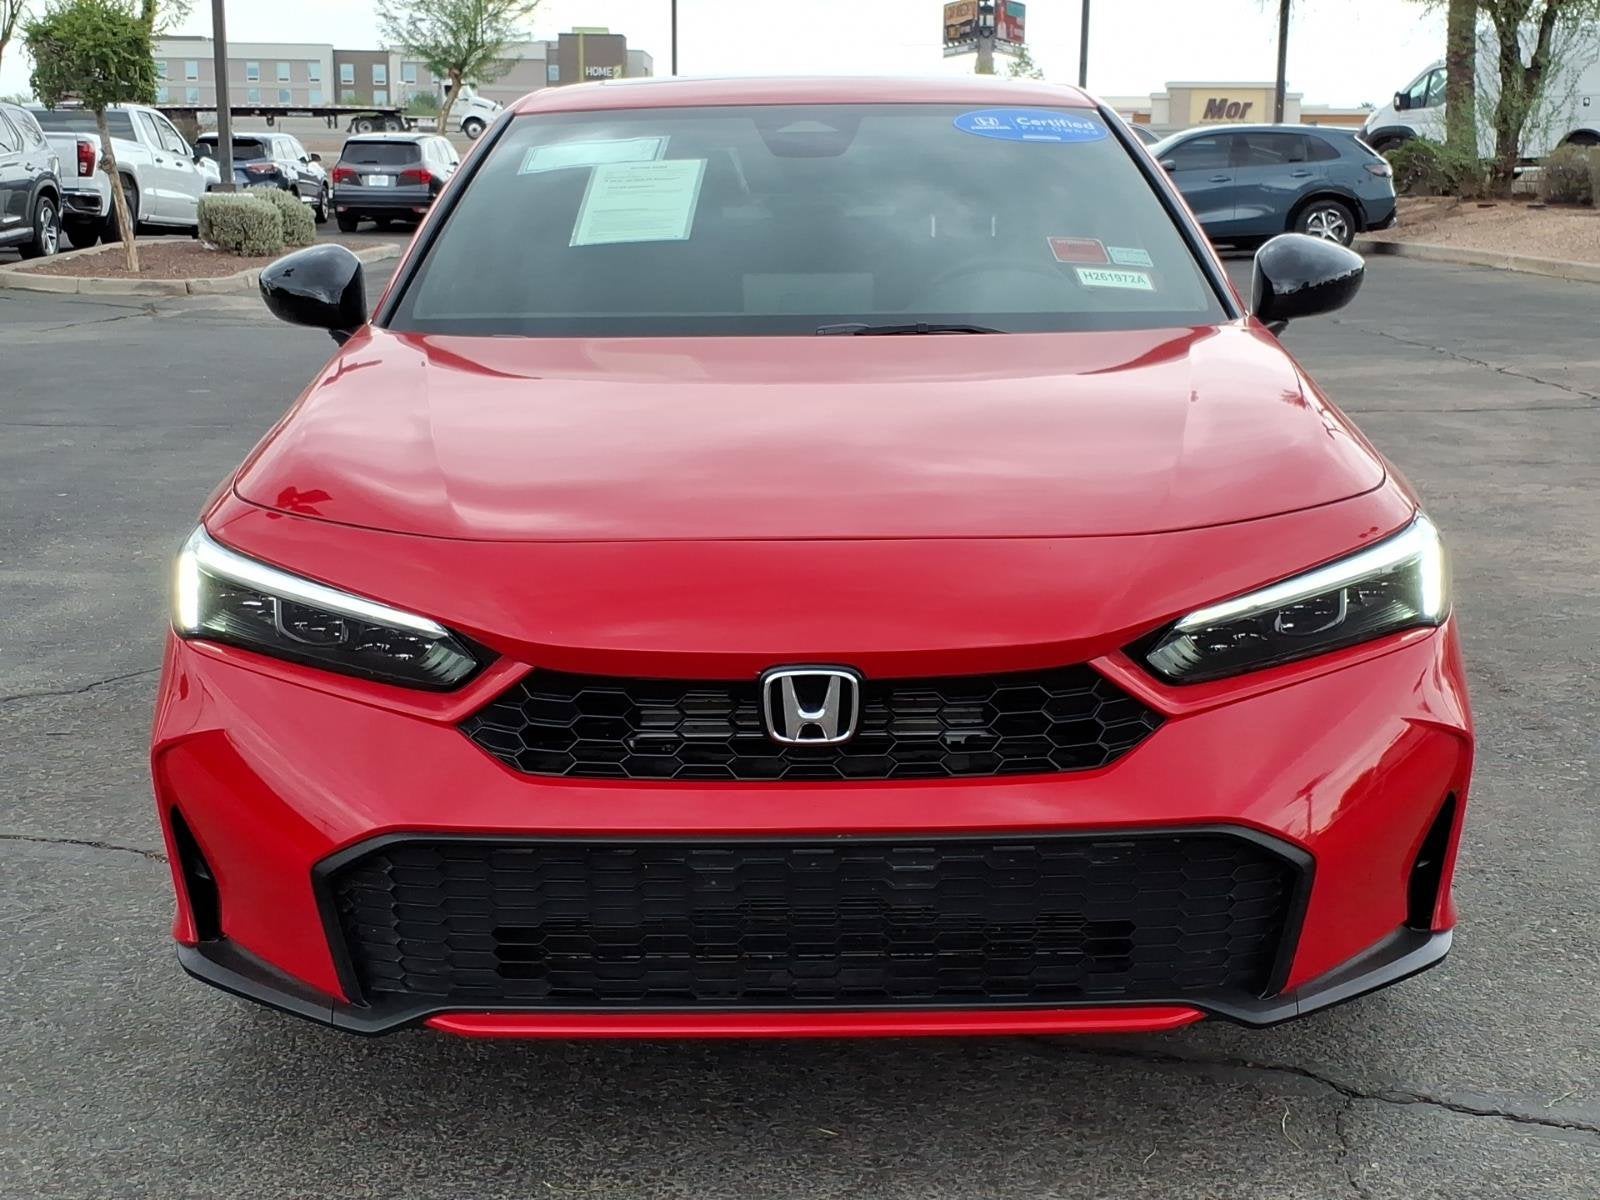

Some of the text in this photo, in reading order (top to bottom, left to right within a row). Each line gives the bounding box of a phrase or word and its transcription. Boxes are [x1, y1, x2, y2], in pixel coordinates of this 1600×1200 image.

[585, 66, 613, 76] HOME
[1202, 98, 1253, 120] Mor
[1016, 117, 1095, 130] Certified
[1083, 271, 1146, 285] H261972A
